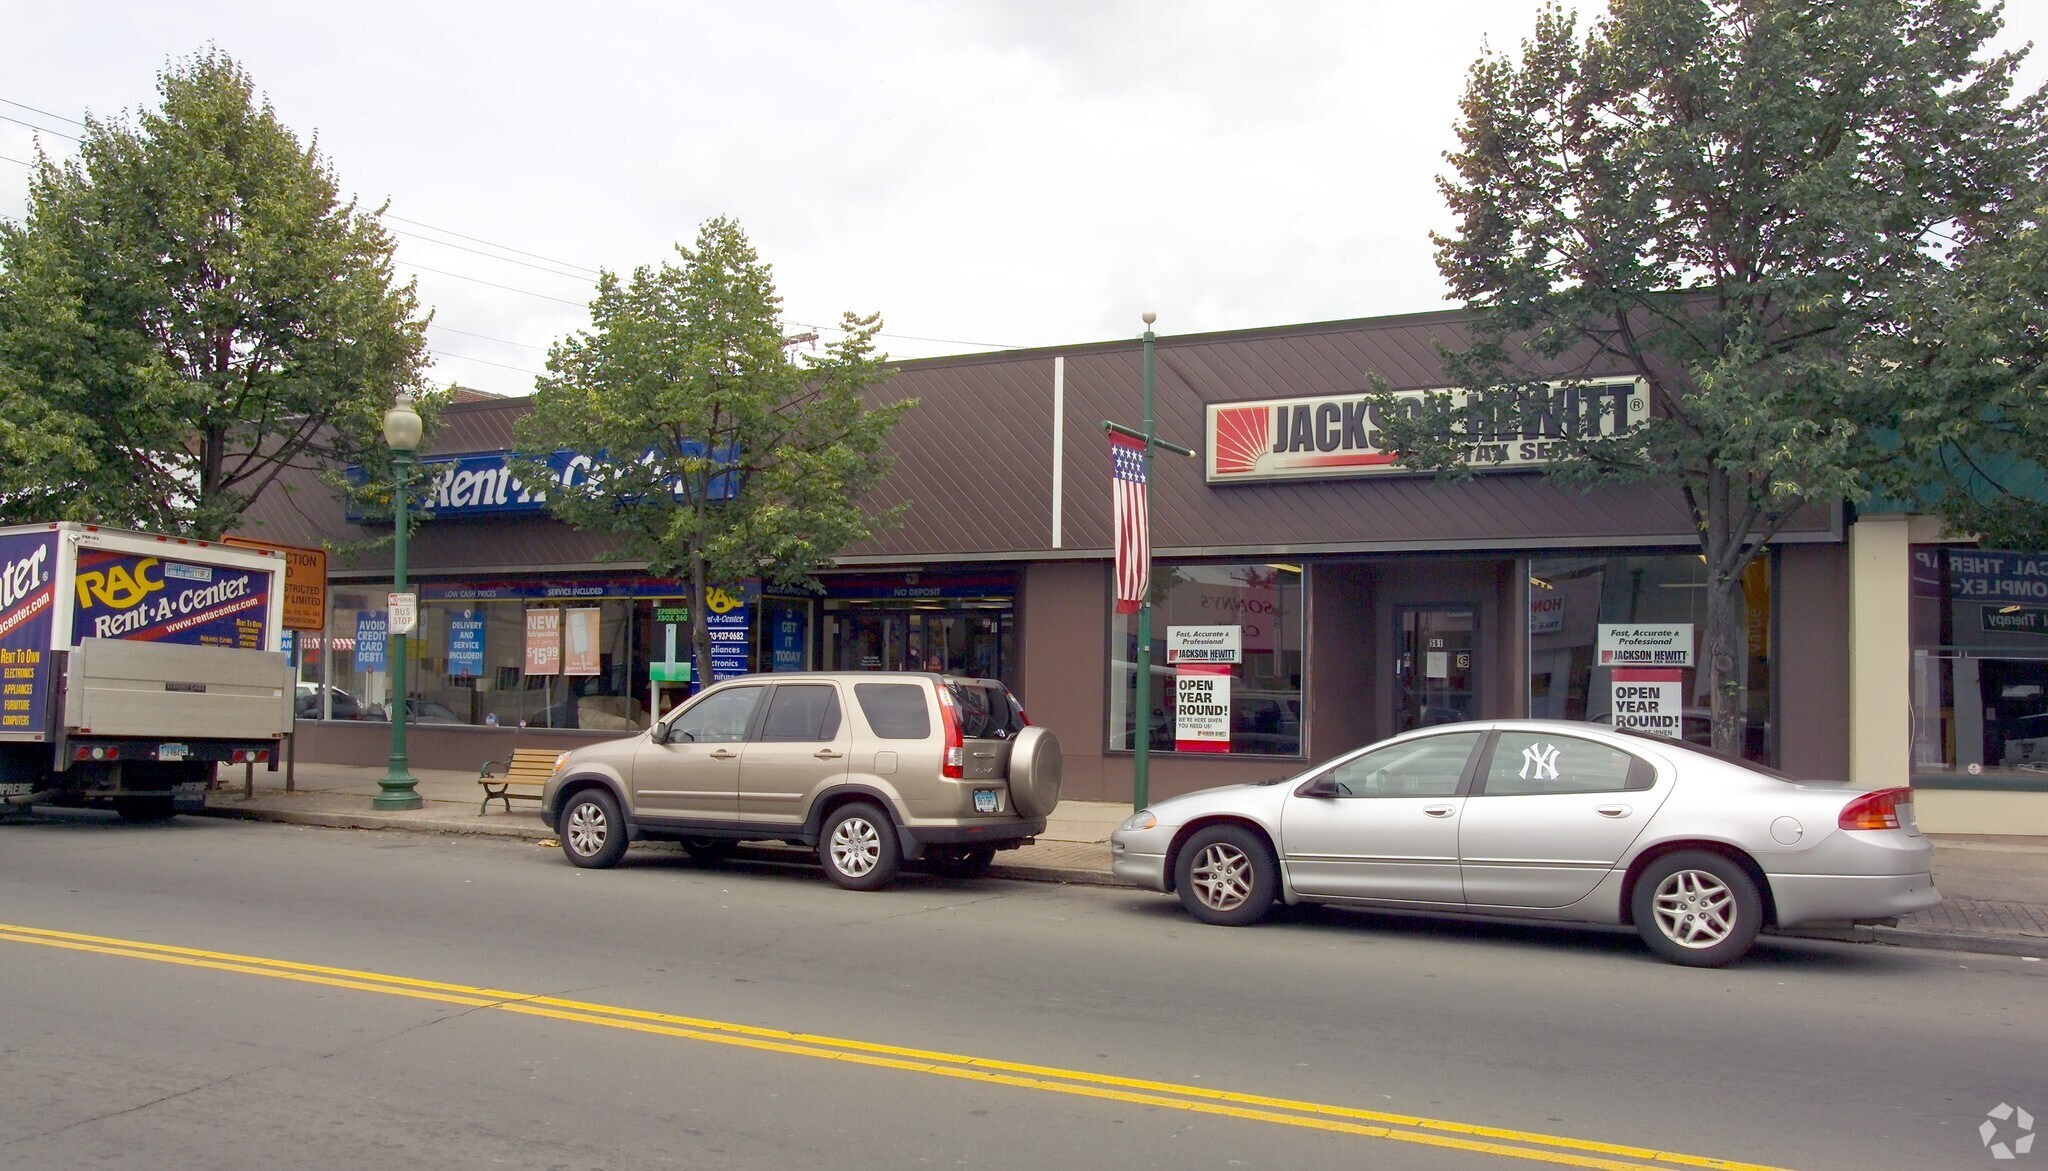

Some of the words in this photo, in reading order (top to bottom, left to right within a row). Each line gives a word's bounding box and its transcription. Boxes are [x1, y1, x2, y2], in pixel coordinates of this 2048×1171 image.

[1460, 442, 1510, 463] TAX
[76, 557, 165, 608] RAC
[460, 590, 476, 598] CASH
[477, 589, 497, 598] PRICES
[548, 588, 571, 596] SERVICE
[572, 587, 603, 596] INCLUDED
[894, 588, 907, 597] NO
[908, 588, 941, 597] DEPOSIT
[292, 596, 320, 606] LIMITED
[166, 597, 257, 633] www.rentacenter.com
[395, 608, 410, 616] BUS
[359, 621, 386, 630] AVOID
[393, 617, 412, 625] STOP
[452, 621, 482, 630] DELIVERY
[527, 615, 559, 630] NEW
[781, 622, 797, 633] GET
[357, 631, 387, 641] CREDIT
[1175, 630, 1191, 638] Fast,
[1193, 630, 1223, 638] Accurate
[1611, 629, 1630, 638] Fast,
[1632, 629, 1672, 637] Accurate
[360, 642, 383, 652] CARD
[453, 641, 479, 649] SERVICE
[784, 636, 792, 647] IT
[1619, 638, 1673, 646] Professional
[358, 652, 384, 662] DEBT!
[449, 652, 483, 660] INCLUDED!
[776, 651, 802, 662] TODAY
[1179, 649, 1208, 658] JACKSON
[1210, 649, 1236, 658] HEWITT
[1614, 650, 1652, 661] JACKSON
[1654, 650, 1687, 661] HEWITT
[4, 667, 35, 679] ELECTRONICS
[4, 684, 33, 695] APPLIANCES
[1179, 680, 1213, 691] OPEN
[1179, 692, 1212, 703] YEAR
[1615, 687, 1660, 699] OPEN
[4, 699, 30, 711] FURNITURE
[1179, 705, 1228, 716] ROUND!
[1616, 701, 1659, 713] YEAR
[3, 715, 30, 726] COMPUTERS
[1615, 715, 1679, 728] ROUND!
[1519, 742, 1561, 780] NY
